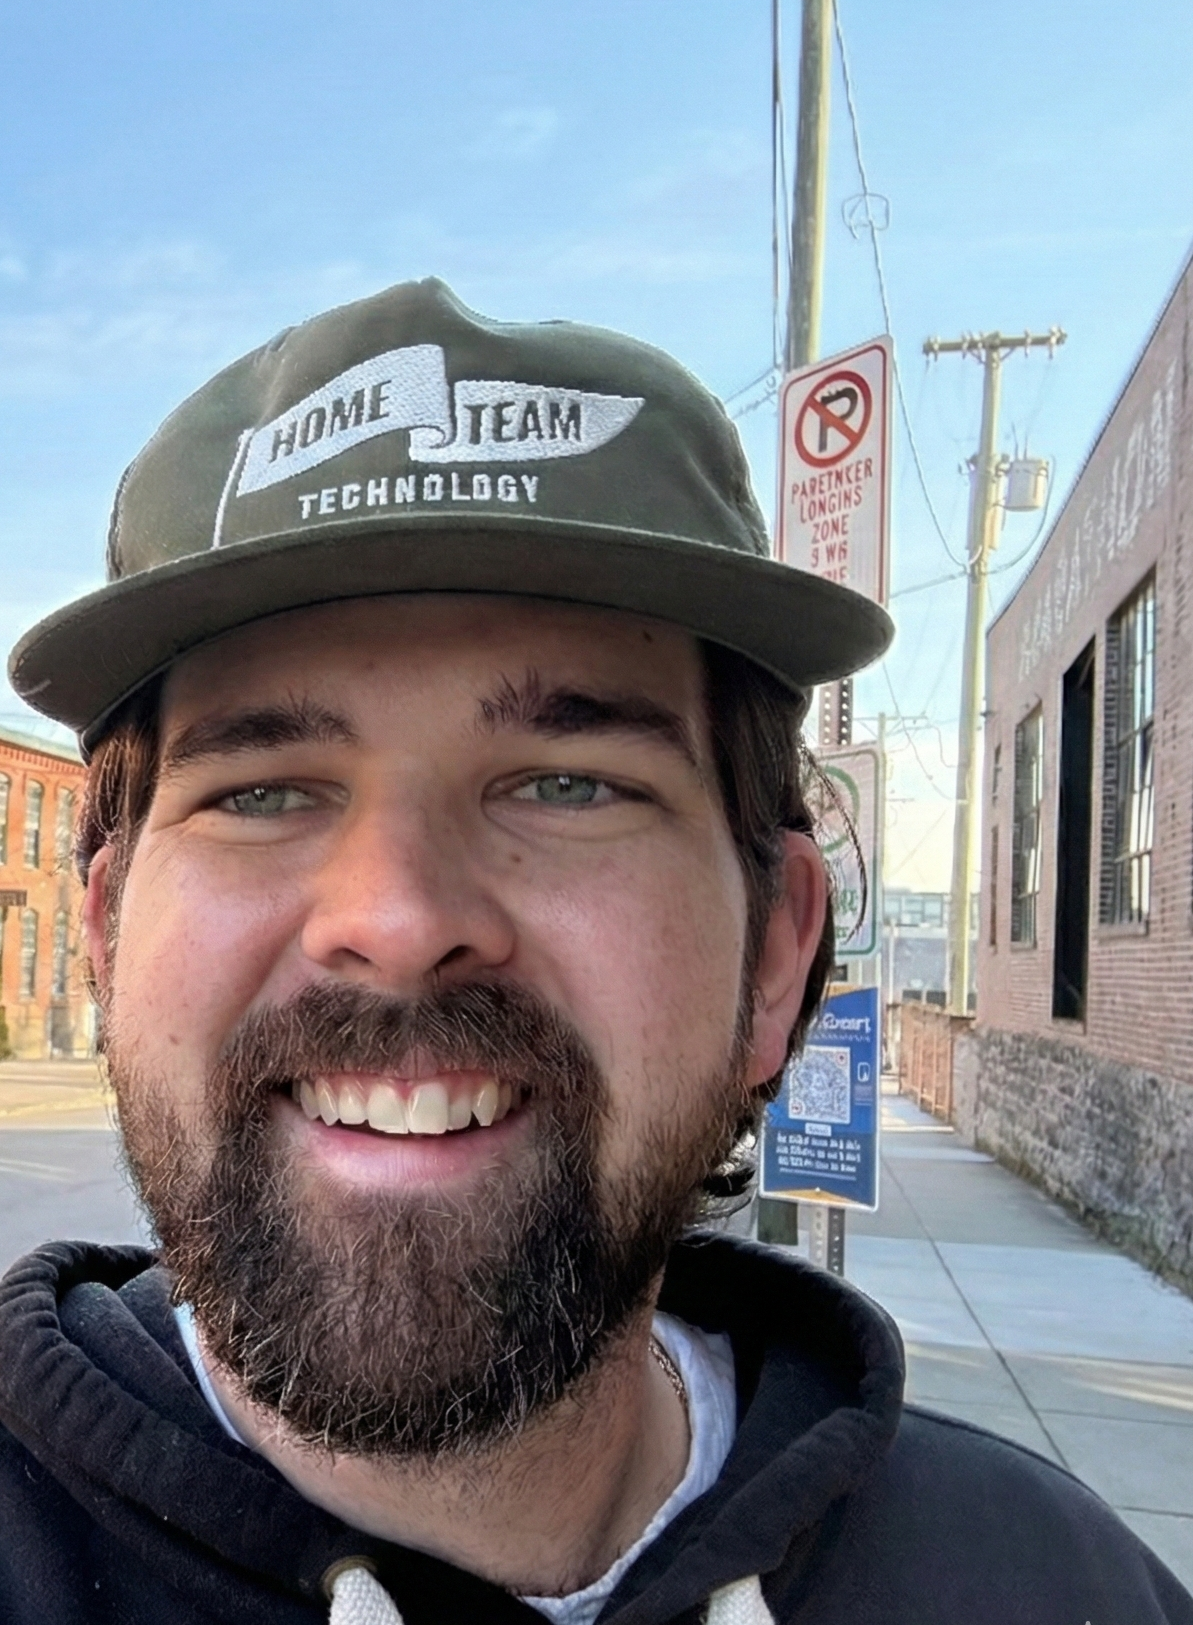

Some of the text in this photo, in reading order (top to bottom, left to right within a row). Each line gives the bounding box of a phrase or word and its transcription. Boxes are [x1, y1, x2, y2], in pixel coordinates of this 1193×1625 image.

[268, 379, 582, 464] HOME TEAM
[297, 471, 540, 520] TECHNOLOGY
[811, 513, 850, 545] ZONE
